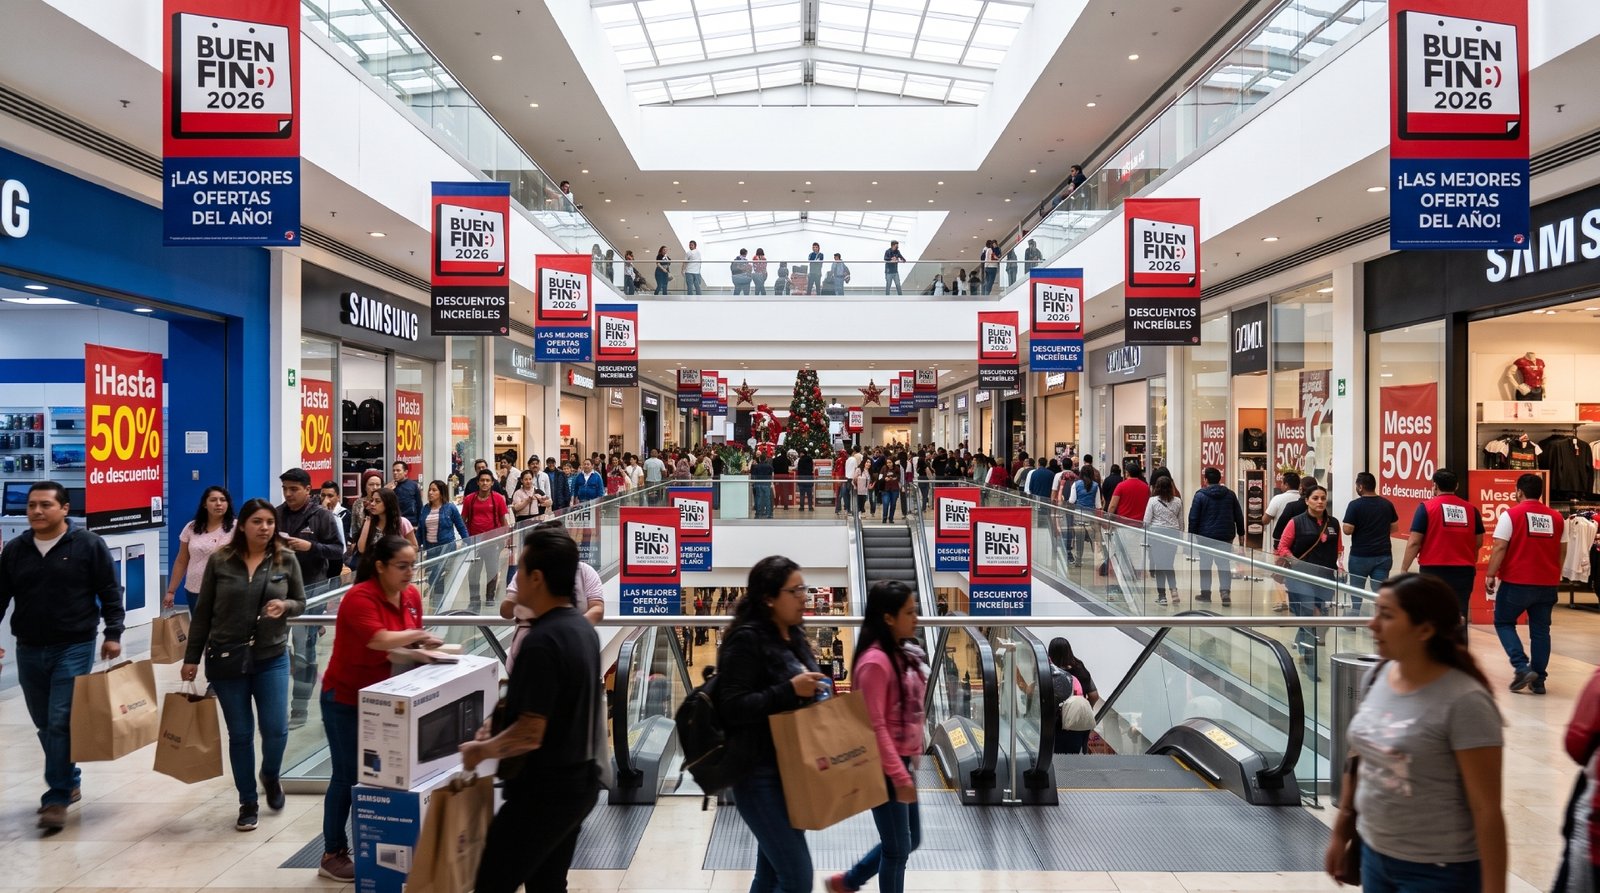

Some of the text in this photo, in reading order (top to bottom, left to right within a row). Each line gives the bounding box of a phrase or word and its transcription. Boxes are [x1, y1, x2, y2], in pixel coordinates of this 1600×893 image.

[197, 35, 275, 62] BUEN
[1423, 33, 1502, 61] BUEN
[207, 92, 264, 109] 2026
[1434, 91, 1492, 109] 2026
[171, 170, 293, 187] ¡LAS MEJORES
[1398, 172, 1521, 190] ¡LAS MEJORES
[193, 191, 271, 205] OFERTAS
[1420, 193, 1499, 208] OFERTAS
[192, 207, 272, 225] DEL AÑO!
[1419, 210, 1501, 228] DEL AÑO!
[450, 217, 495, 232] BUEN
[1143, 230, 1186, 245] BUEN
[455, 249, 489, 259] 2026
[1148, 261, 1181, 271] 2026
[549, 277, 581, 290] BUEN
[436, 296, 505, 306] DESCUENTOS
[1042, 291, 1073, 303] BUEN
[552, 301, 576, 309] 2026
[1129, 308, 1196, 317] DESCUENTOS
[349, 291, 419, 341] SAMSUNG
[440, 307, 500, 319] INCREÍBLES
[606, 322, 630, 332] BUEN
[1133, 319, 1192, 329] INCREÍBLES
[987, 328, 1012, 337] BUEN
[562, 346, 580, 354] AÑO!
[1035, 353, 1078, 361] INCREÍBLES
[301, 385, 329, 409] Hasta
[1384, 410, 1432, 434] Meses
[90, 404, 160, 461] 50%
[397, 419, 421, 451] 50%
[1203, 424, 1224, 439] Meses
[1277, 423, 1305, 439] Meses
[1202, 441, 1224, 465] 50%
[1276, 443, 1305, 470] 50%
[1382, 441, 1434, 480] 50%
[90, 465, 160, 484] de descuento!
[1382, 483, 1434, 499] de descuento!
[1480, 489, 1517, 501] Mese
[679, 504, 704, 513] BUEN
[1481, 503, 1511, 522] 50
[634, 531, 669, 543] BUEN
[984, 531, 1019, 543] BUEN
[623, 589, 640, 597] ¡LAS
[973, 591, 1028, 599] DESCUENTOS
[649, 604, 669, 613] AÑO!
[976, 600, 1024, 609] INCREÍBLES
[357, 794, 391, 804] SAMSUNG
